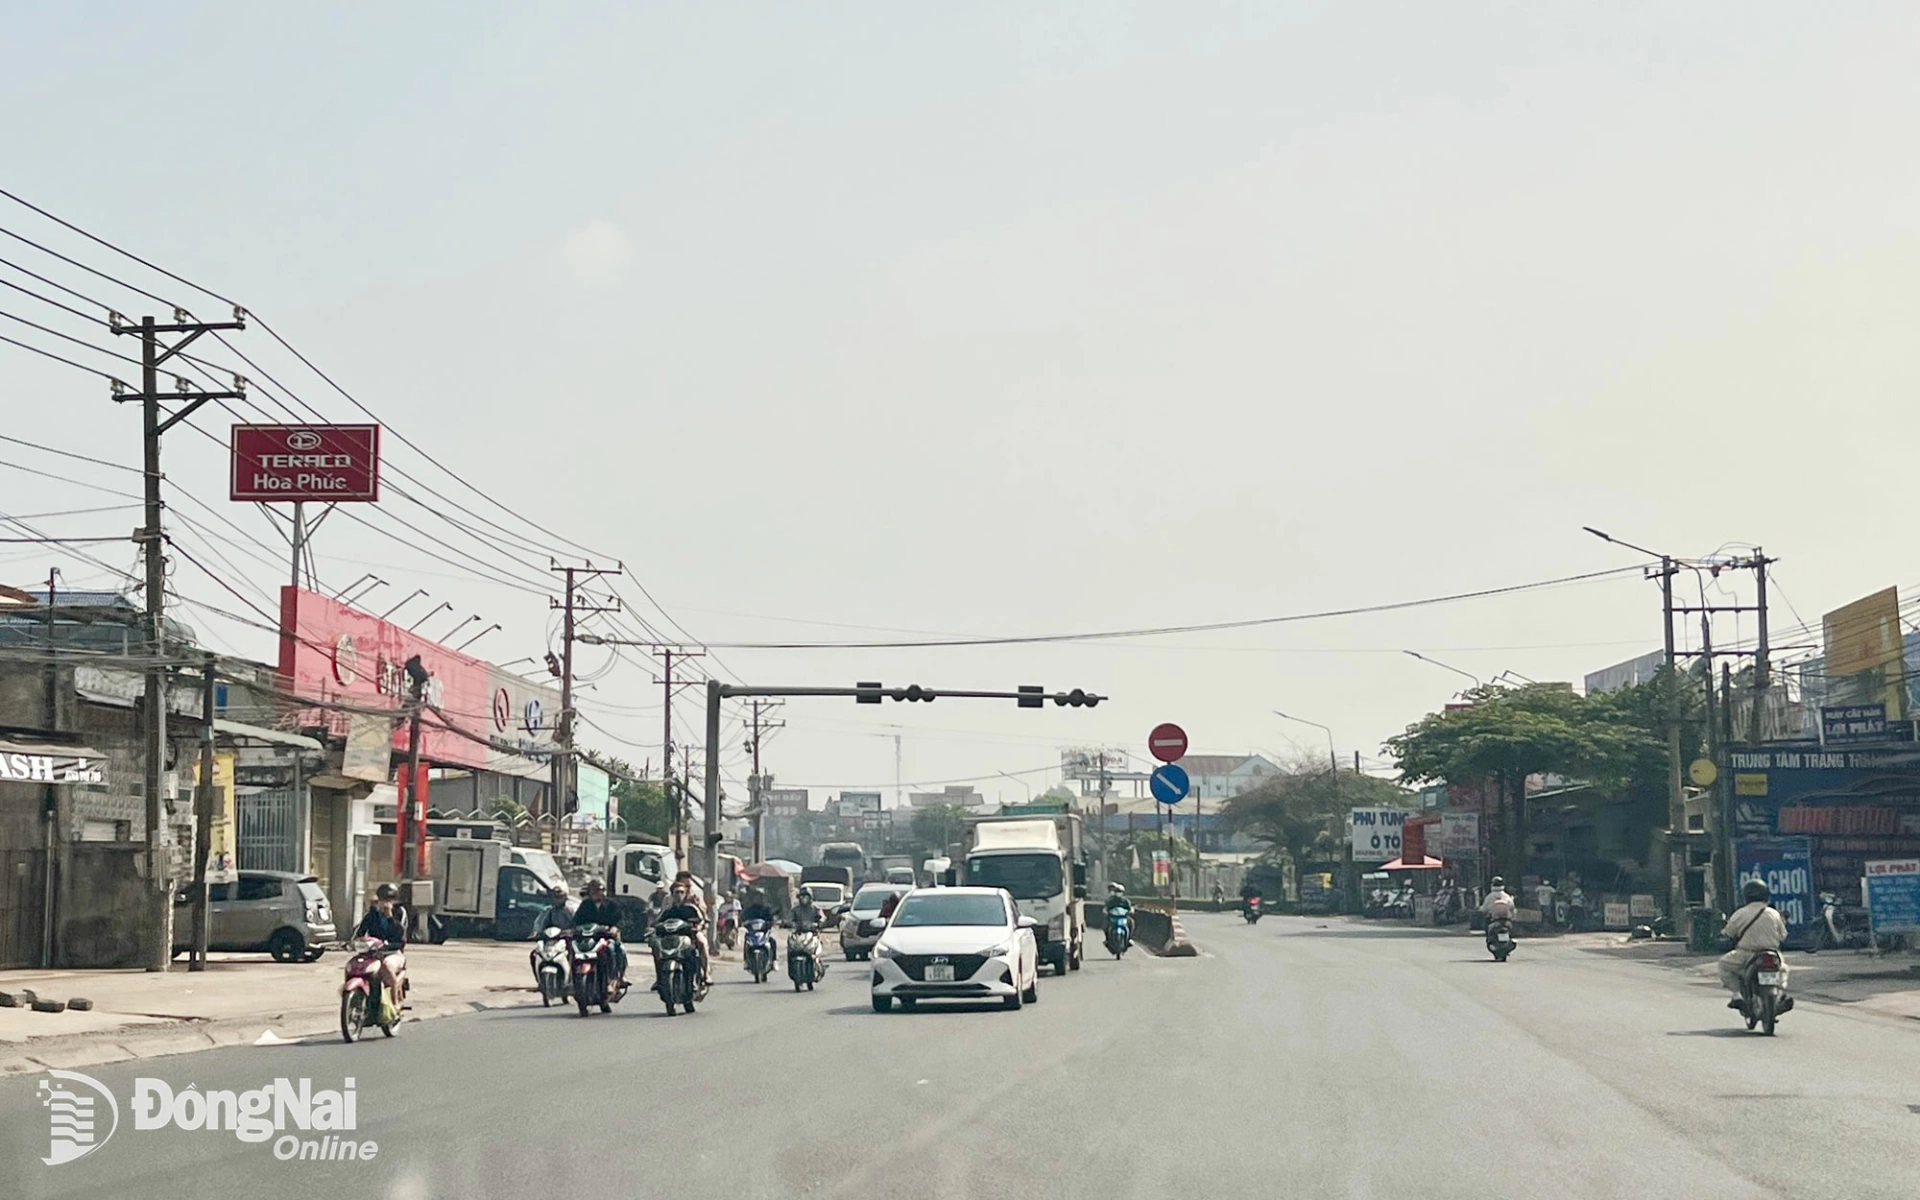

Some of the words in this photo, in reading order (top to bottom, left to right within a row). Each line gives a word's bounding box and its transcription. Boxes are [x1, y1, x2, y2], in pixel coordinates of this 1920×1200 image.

[257, 454, 351, 468] TERACO
[297, 472, 347, 489] Phúc
[1731, 753, 1771, 768] TRUNG
[1775, 751, 1800, 768] TÂM
[1804, 753, 1845, 768] TRANG
[1767, 867, 1808, 895] CHƠI
